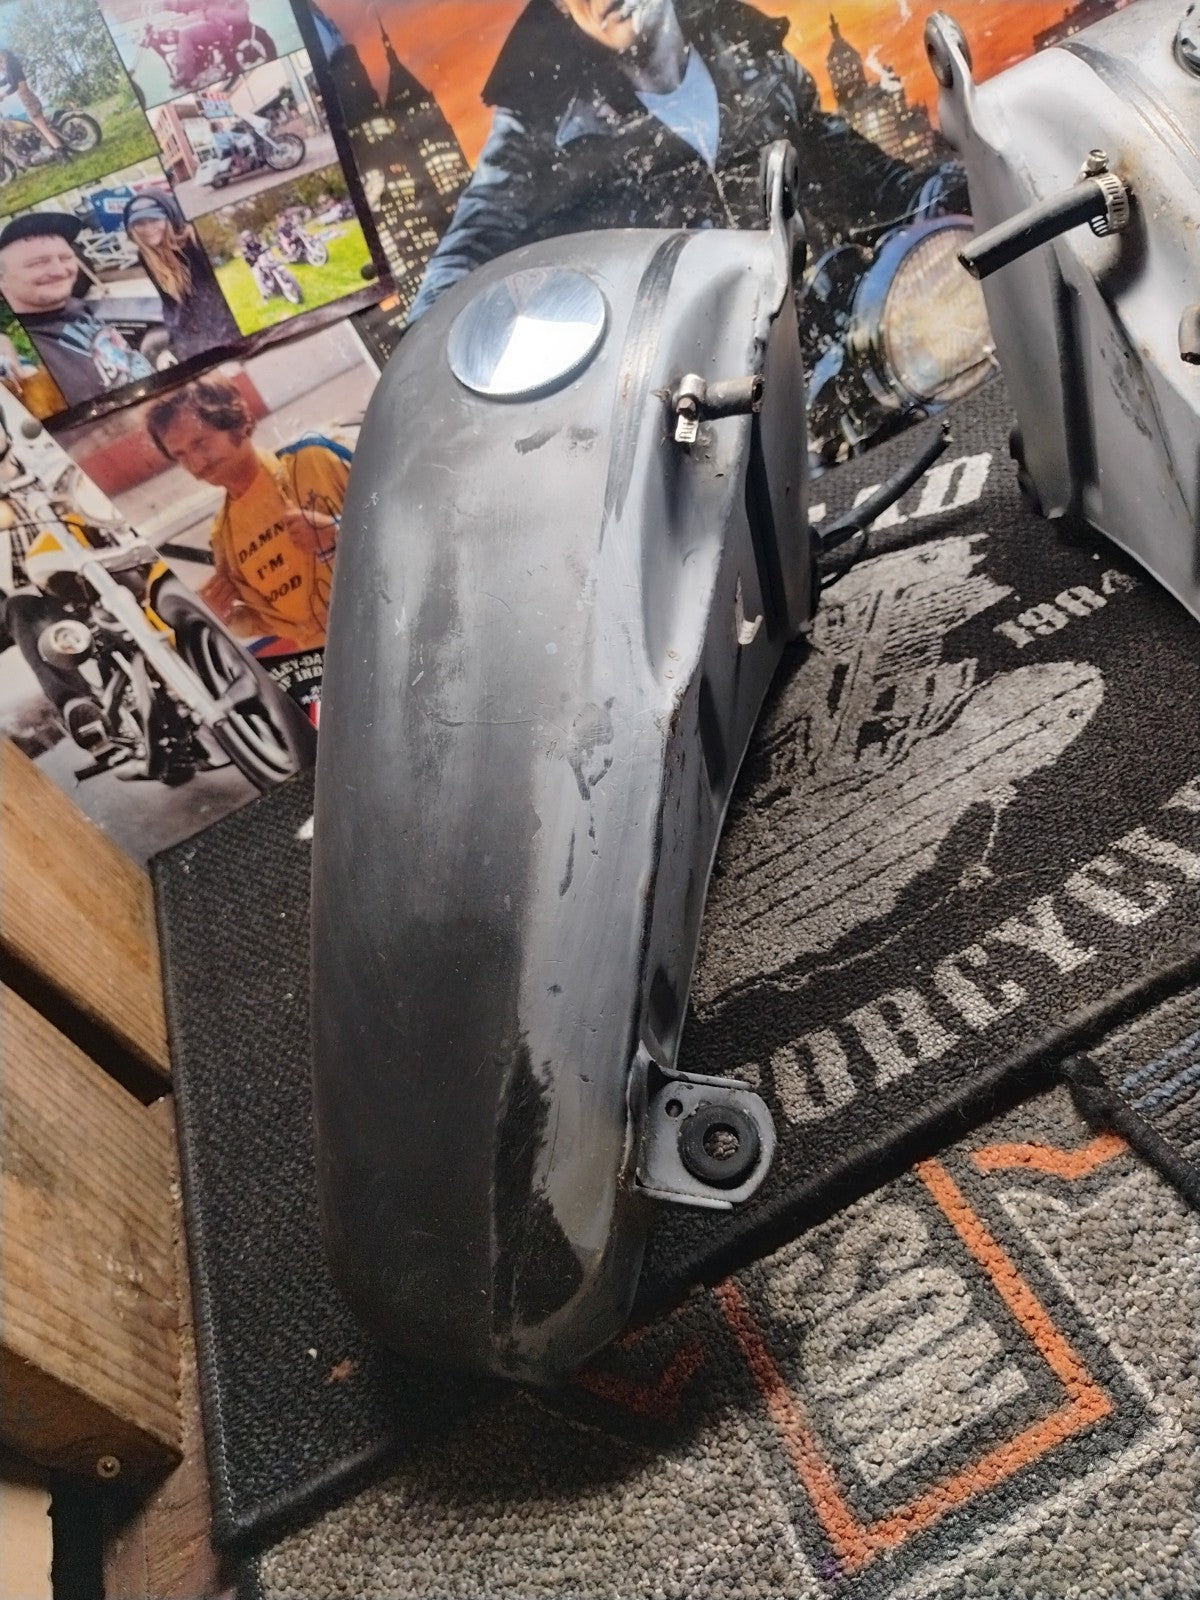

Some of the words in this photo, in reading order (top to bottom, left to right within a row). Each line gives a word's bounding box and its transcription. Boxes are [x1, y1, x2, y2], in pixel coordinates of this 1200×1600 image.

[238, 521, 285, 564] DAMN
[256, 553, 284, 581] I'M
[268, 652, 324, 681] LEY-DA
[294, 665, 323, 683] IND
